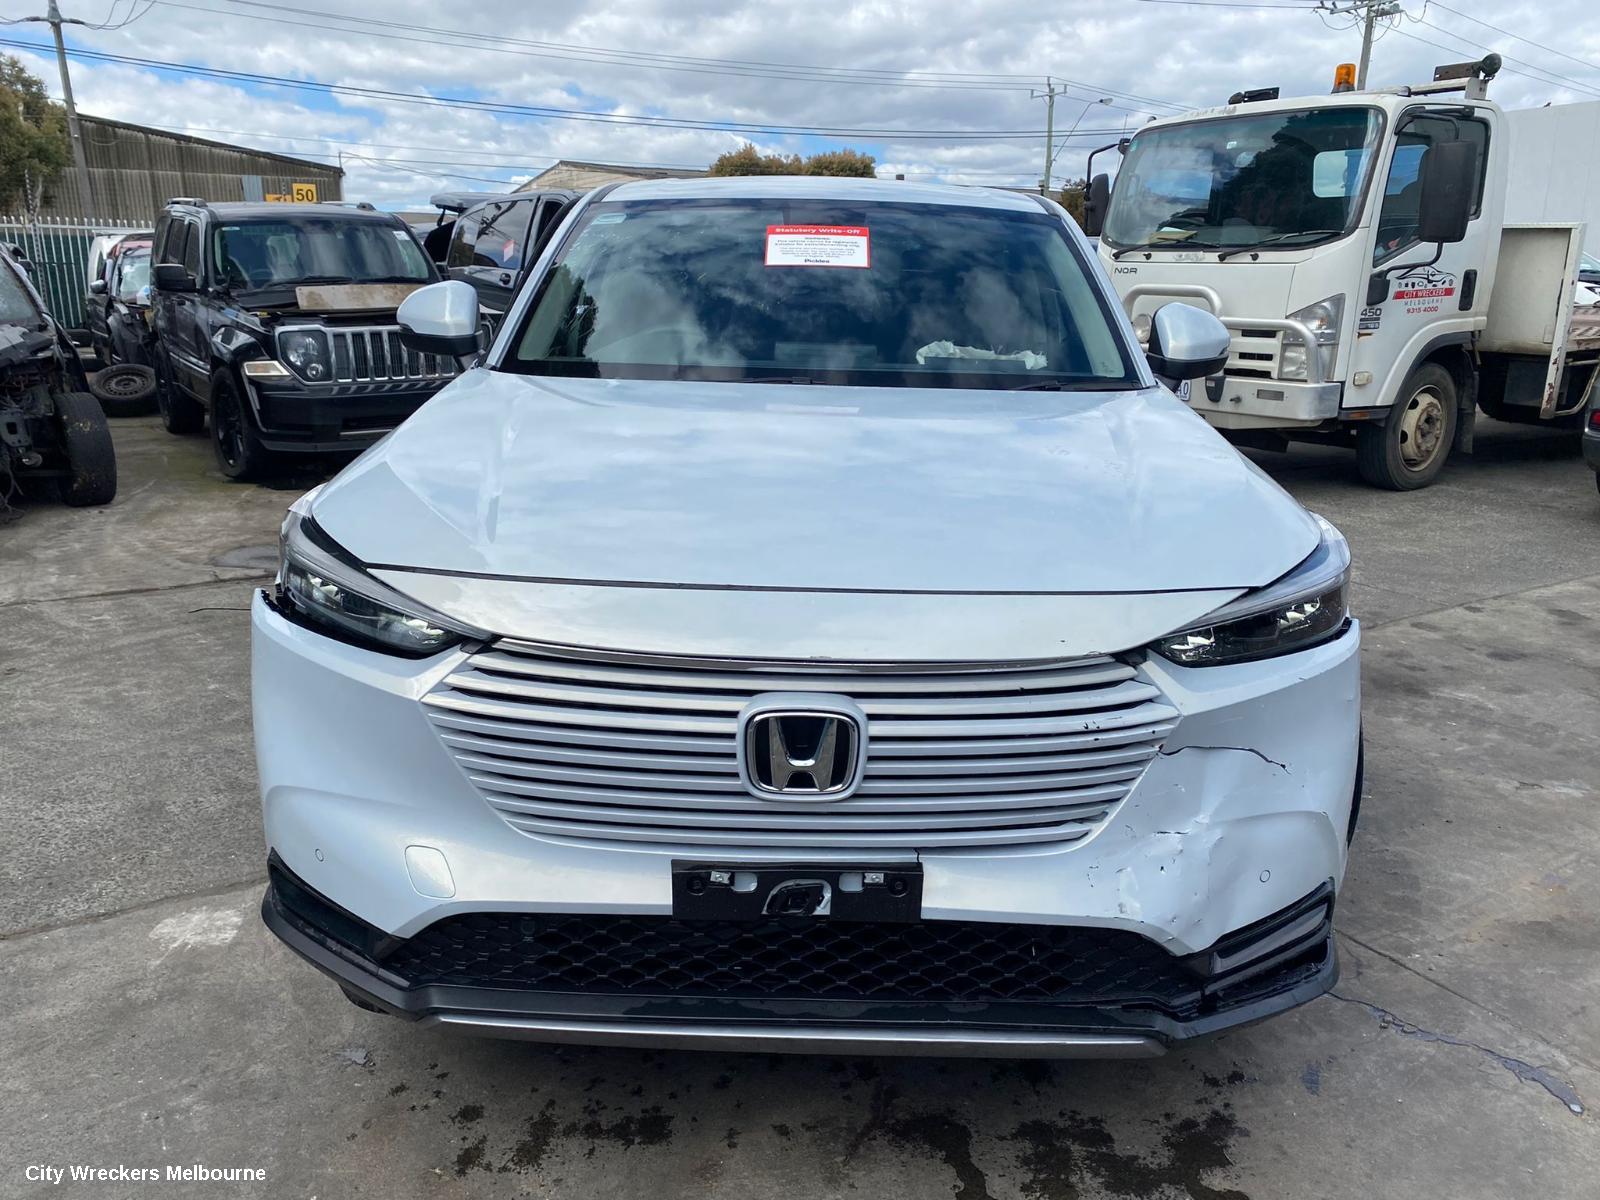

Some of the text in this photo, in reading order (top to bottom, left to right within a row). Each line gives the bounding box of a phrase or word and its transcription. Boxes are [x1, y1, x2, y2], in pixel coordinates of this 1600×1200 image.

[296, 188, 314, 202] 50
[1417, 288, 1446, 297] WRECKERS
[1360, 307, 1382, 317] 450
